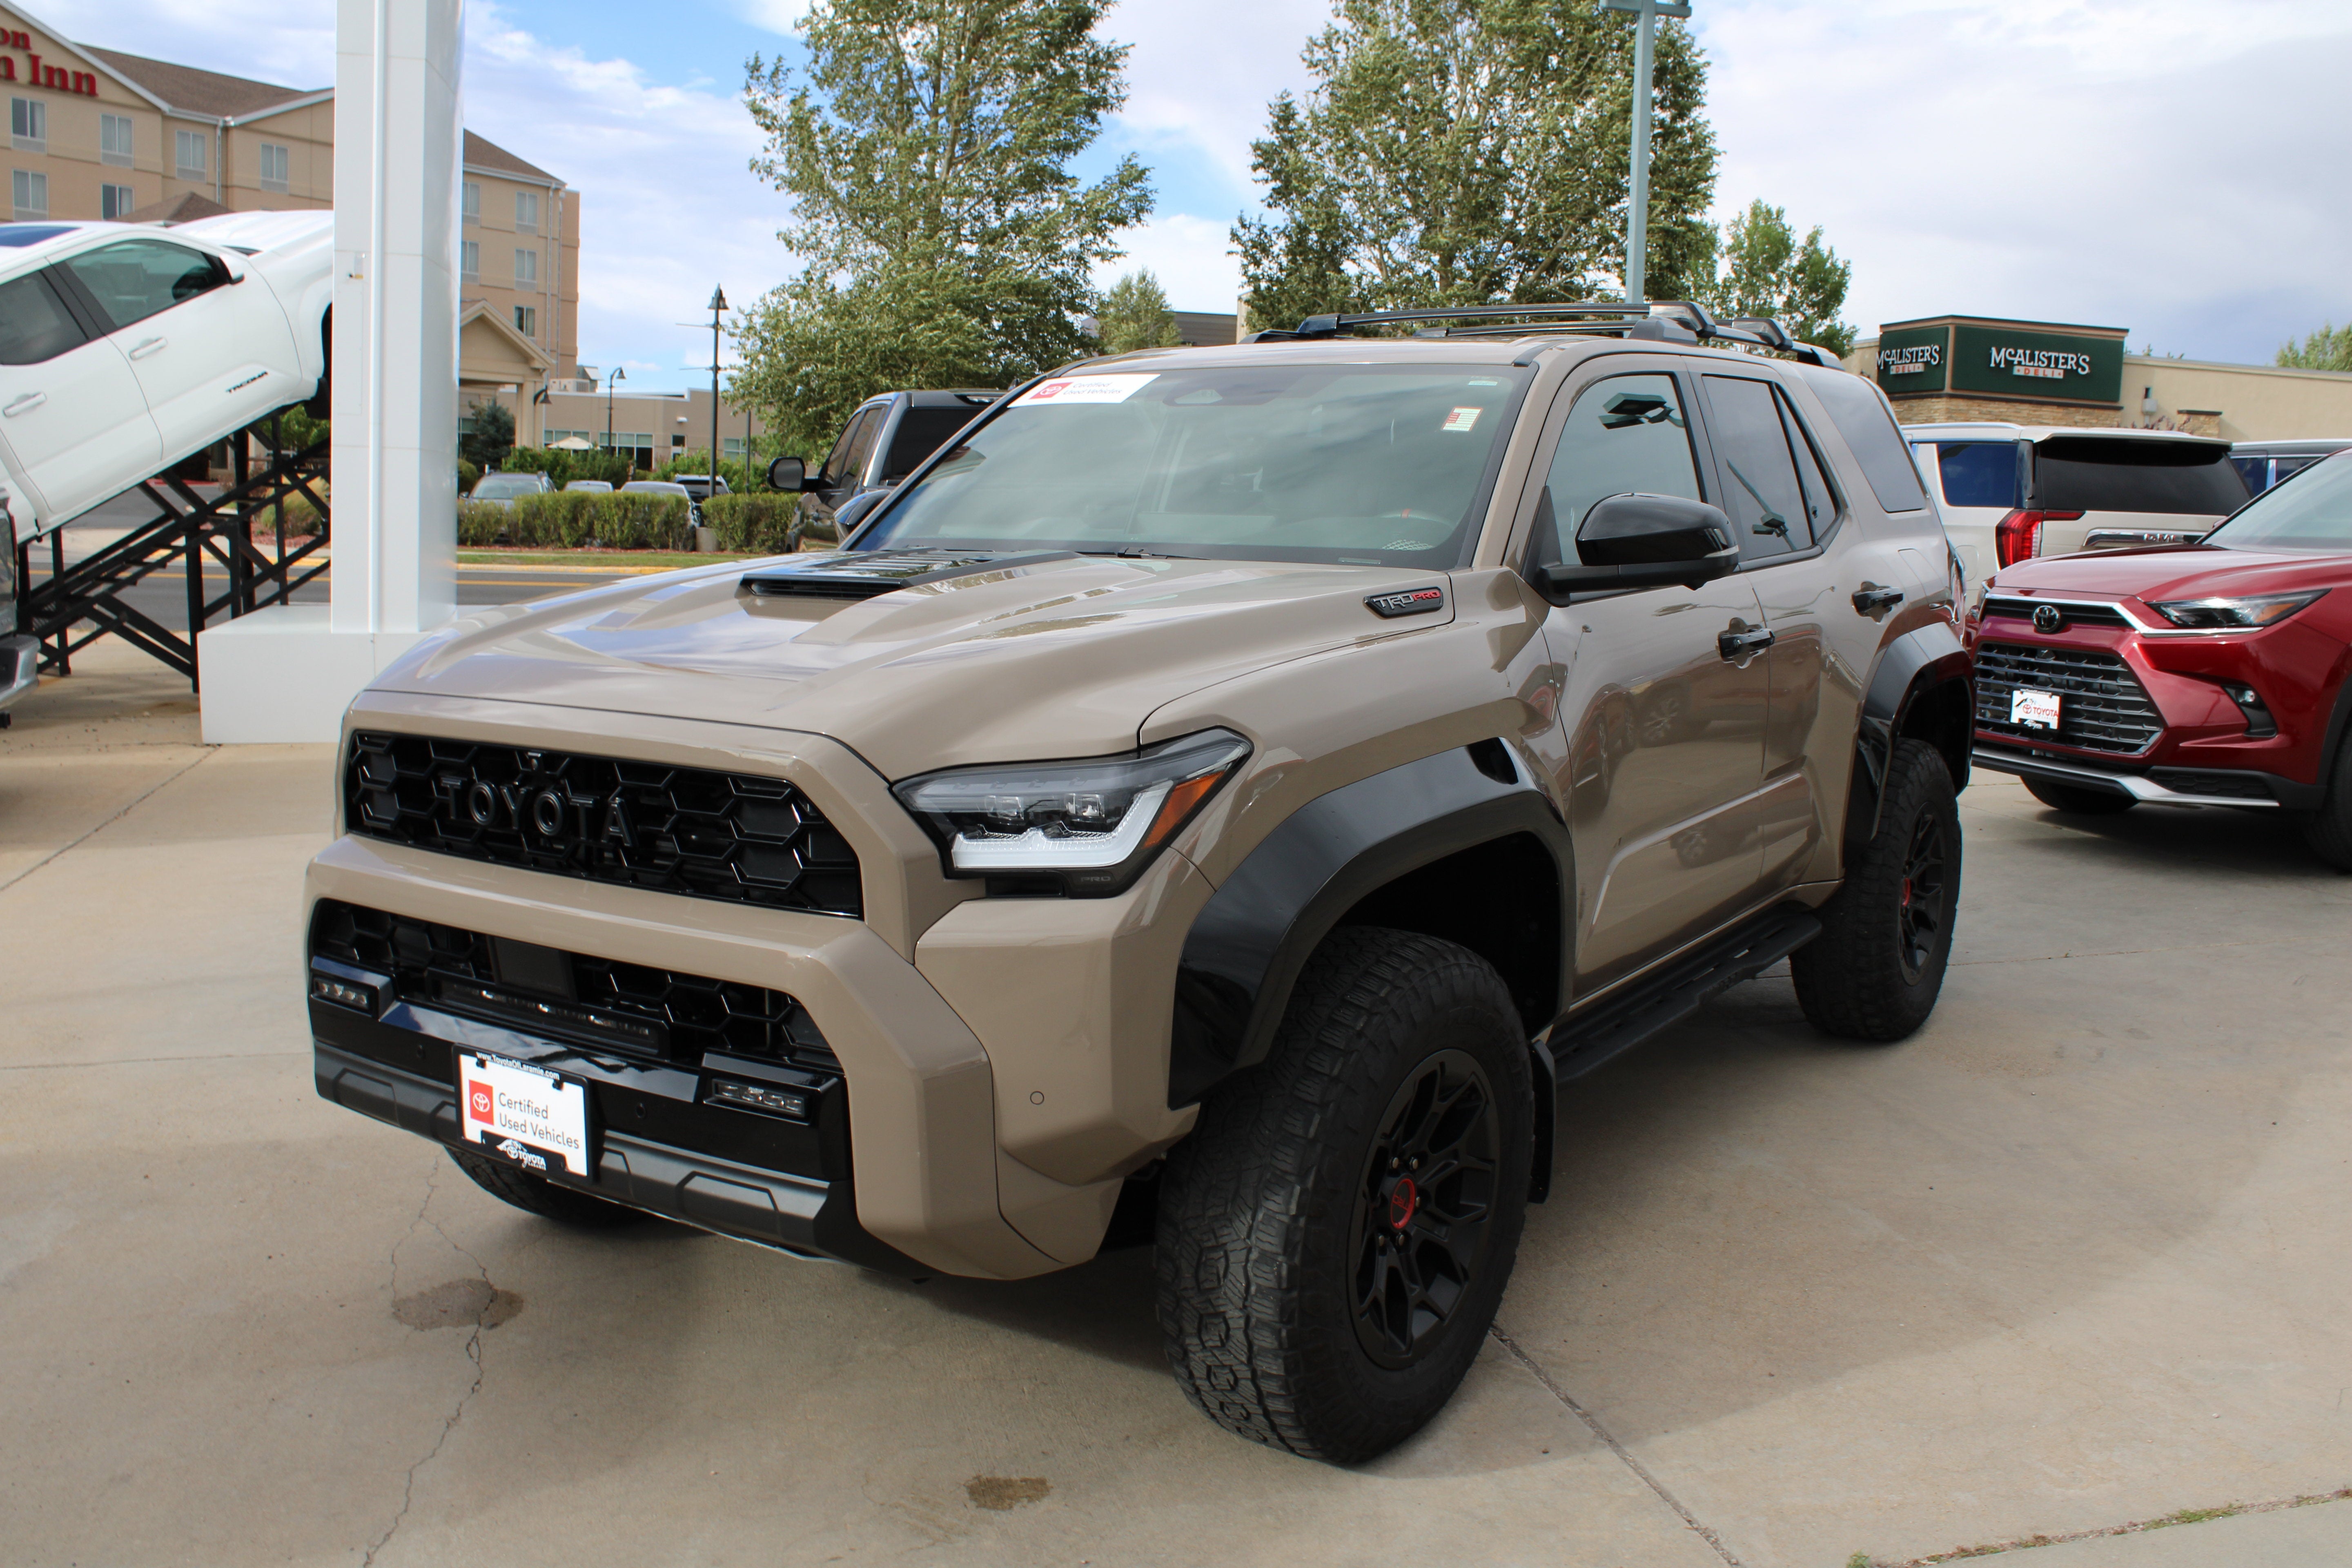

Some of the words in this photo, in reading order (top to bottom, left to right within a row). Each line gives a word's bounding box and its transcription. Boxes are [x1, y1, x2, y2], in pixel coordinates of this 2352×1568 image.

[27, 52, 99, 97] Inn
[1895, 365, 1916, 374] DELI
[2024, 368, 2054, 377] DELI
[2033, 706, 2059, 717] TOYOTA
[439, 775, 635, 847] TOYOTA
[499, 1092, 548, 1120] Certified
[499, 1112, 527, 1134] Used
[530, 1122, 579, 1149] Vehicles
[518, 1149, 546, 1167] TOYOTA
